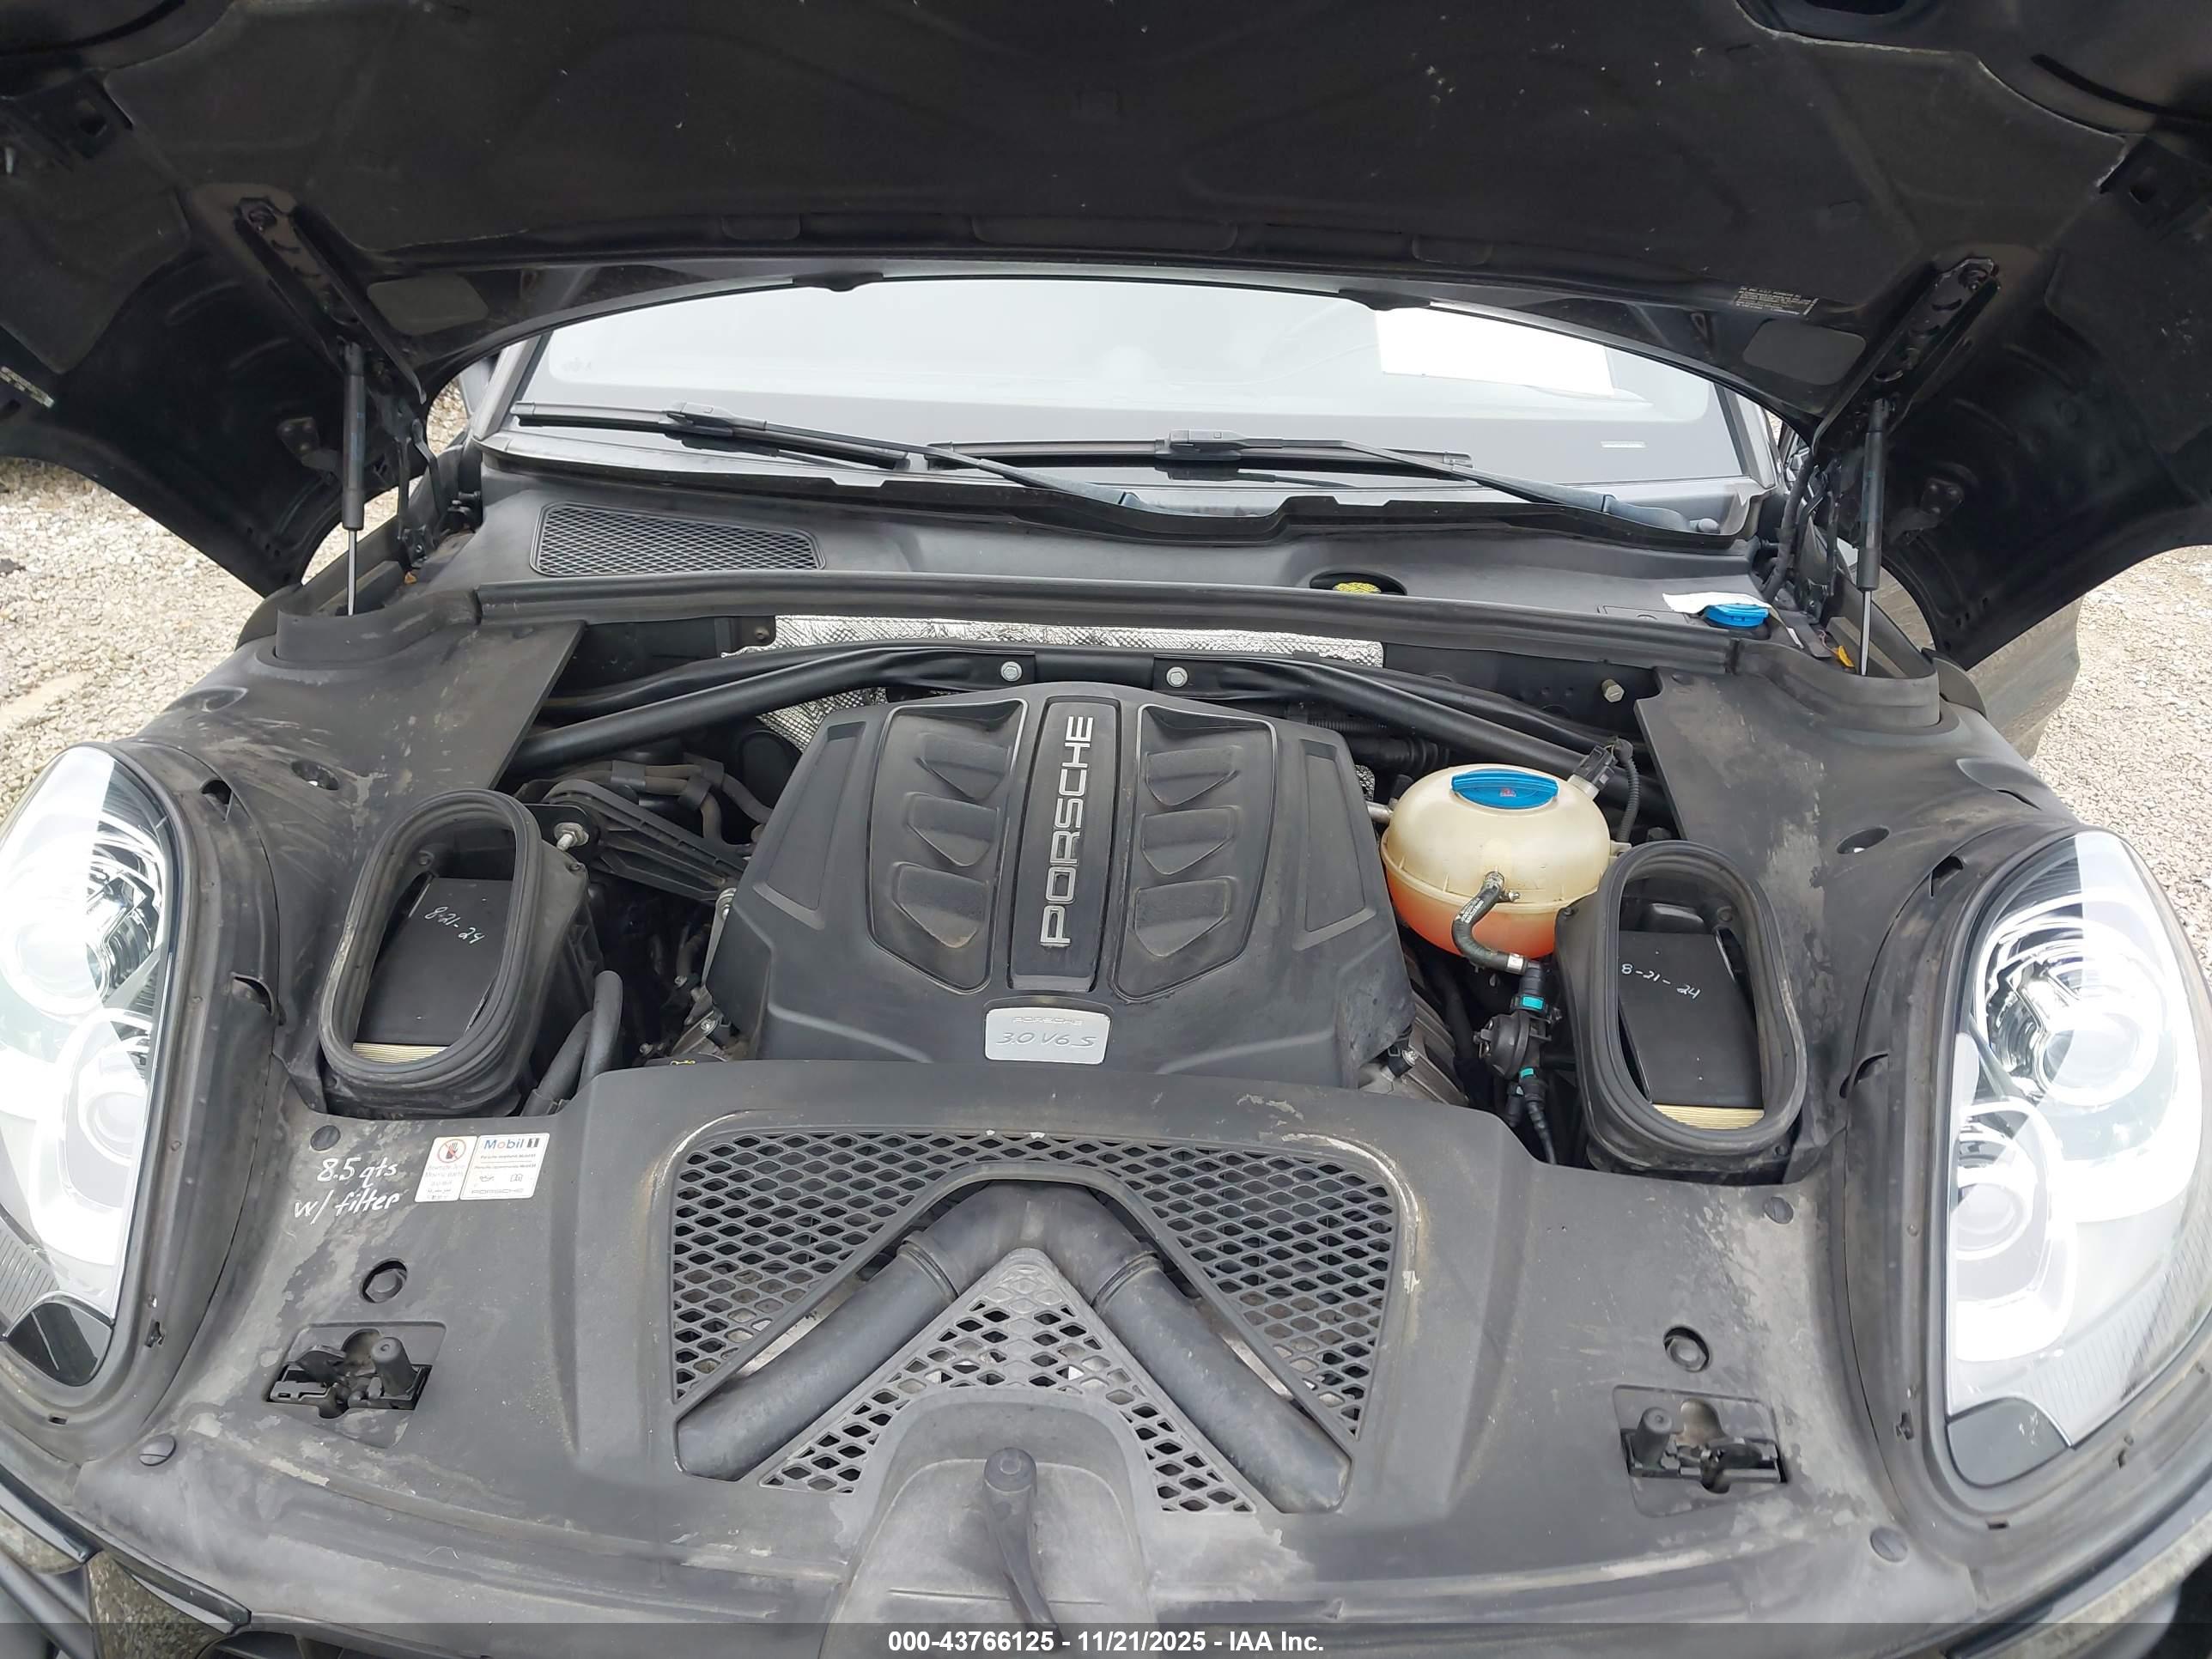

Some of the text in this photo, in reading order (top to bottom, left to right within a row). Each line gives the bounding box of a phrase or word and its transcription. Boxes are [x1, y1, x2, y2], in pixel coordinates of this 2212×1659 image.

[1039, 715, 1094, 948] PORSCHE
[1012, 1016, 1085, 1026] PORSCHE
[996, 1032, 1097, 1048] 3.0 V6 S
[483, 1138, 526, 1151] Mobil
[316, 1157, 398, 1188] 8.5 qts
[334, 1188, 404, 1217] filter
